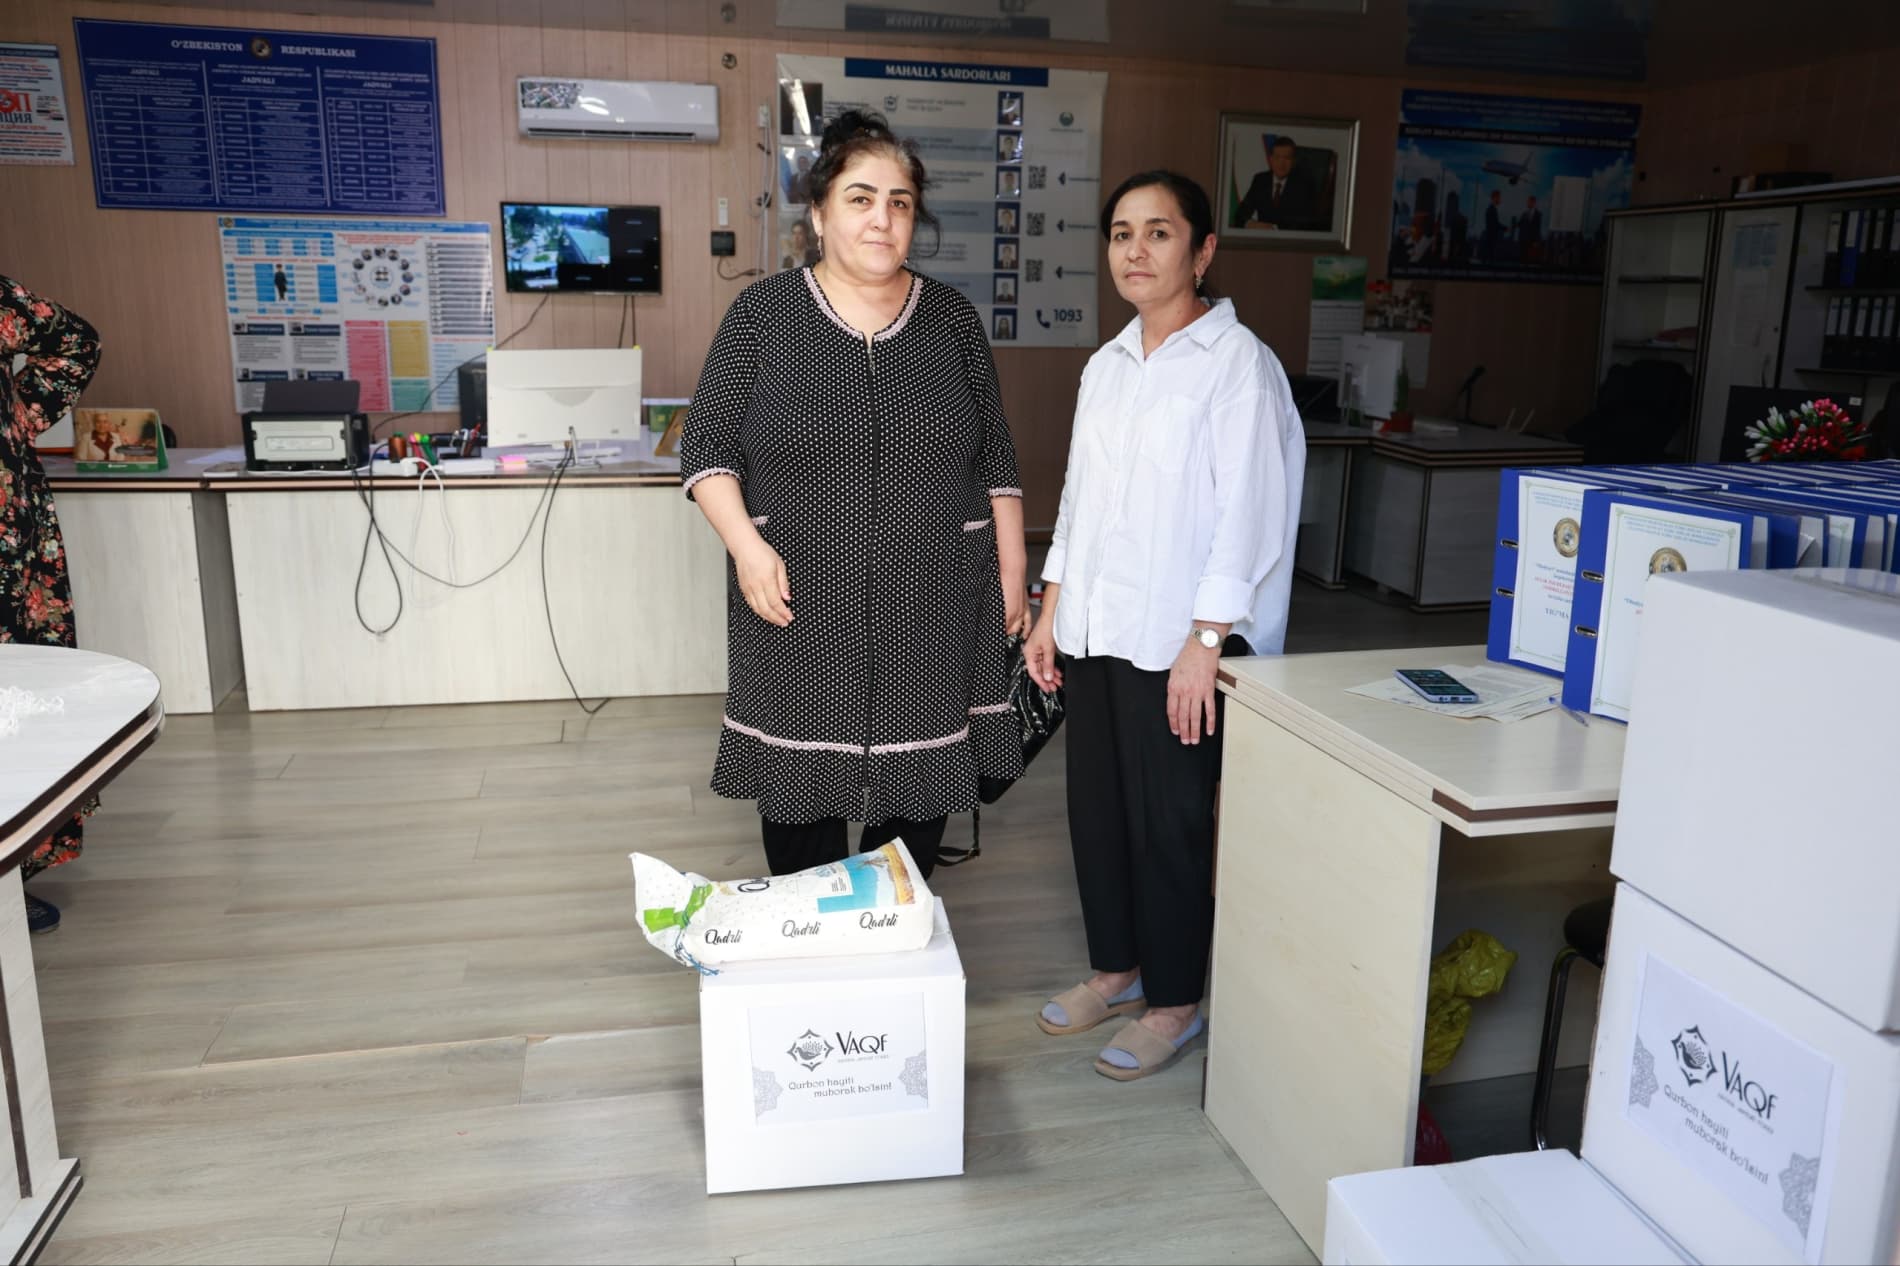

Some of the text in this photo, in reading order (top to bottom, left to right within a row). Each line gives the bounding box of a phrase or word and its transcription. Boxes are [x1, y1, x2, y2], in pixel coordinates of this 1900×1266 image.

[281, 45, 357, 58] RESPUBLIKASI
[241, 76, 276, 85] JADVALI
[885, 64, 1011, 82] MAHALLA SARDORLARI
[1054, 308, 1083, 323] 1093
[835, 1030, 889, 1056] VAQF
[788, 1077, 854, 1091] Qurbon hayiti
[814, 1085, 856, 1098] muborak
[1722, 1050, 1778, 1120] VAQF
[1663, 1083, 1699, 1118] Qurbon
[1701, 1109, 1729, 1140] hayiti
[1684, 1116, 1728, 1156] muborak
